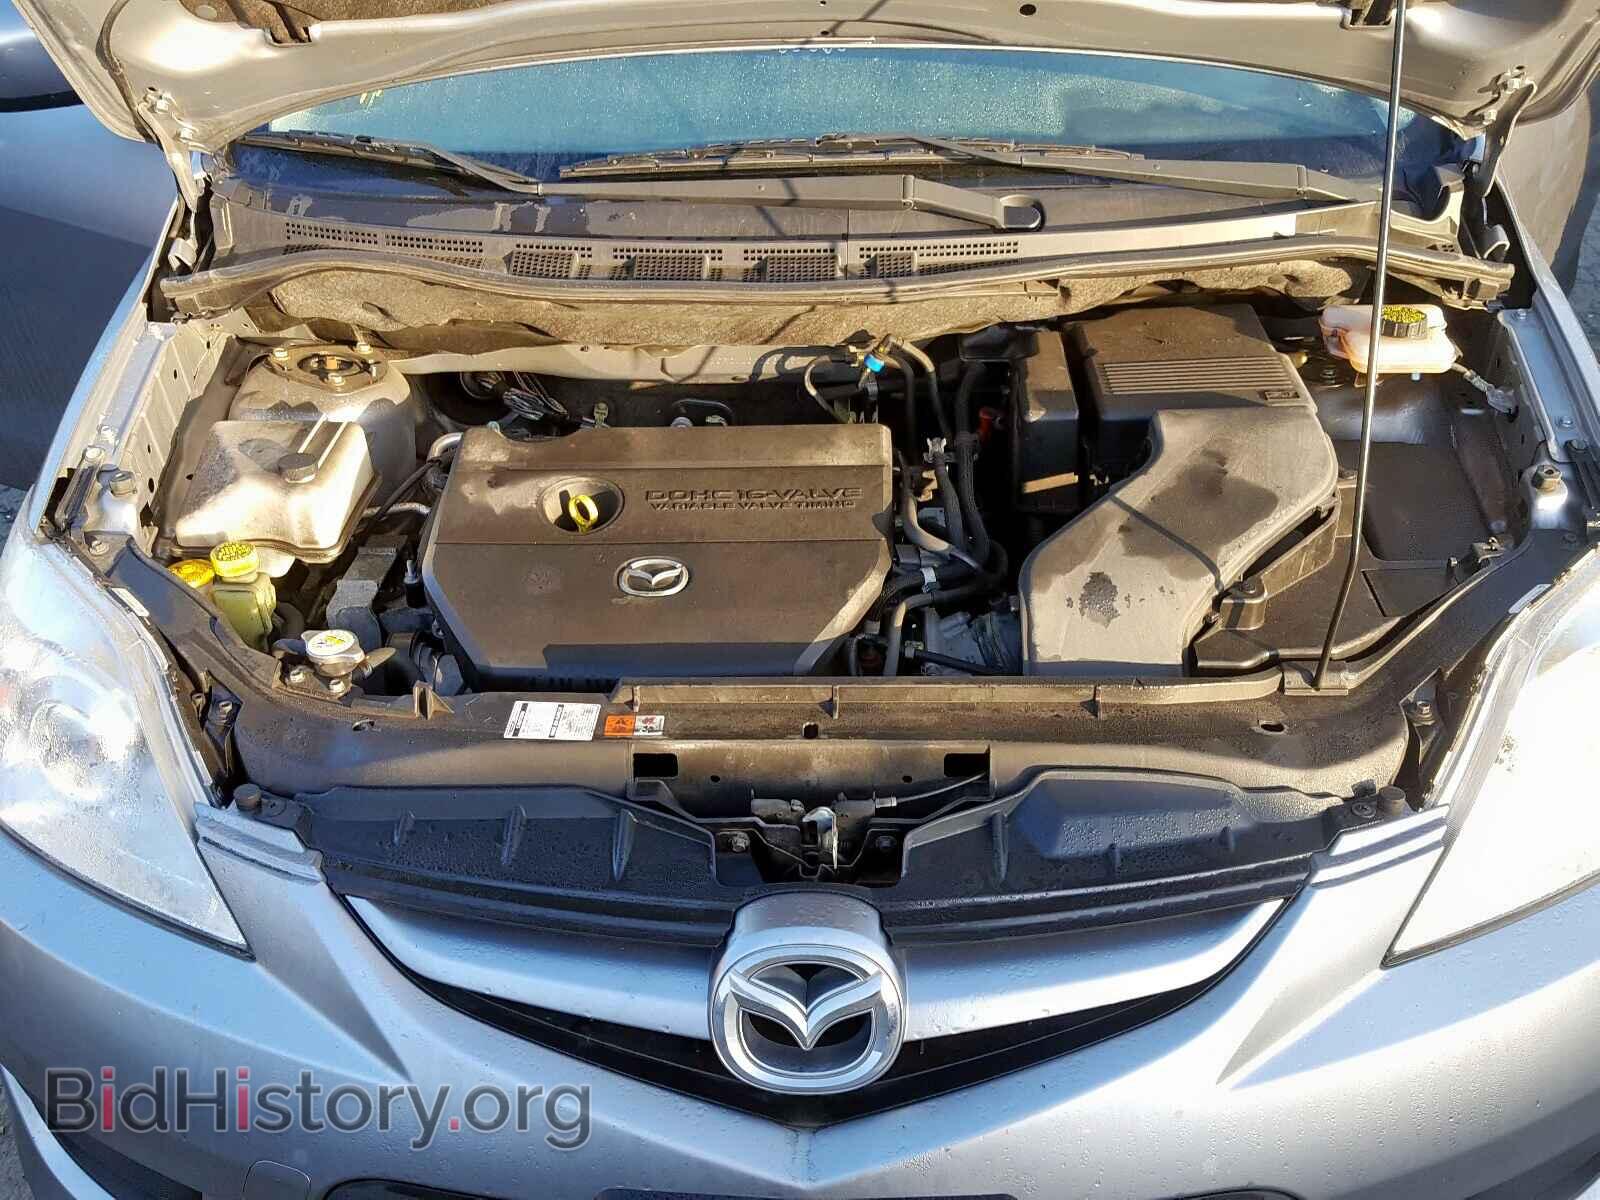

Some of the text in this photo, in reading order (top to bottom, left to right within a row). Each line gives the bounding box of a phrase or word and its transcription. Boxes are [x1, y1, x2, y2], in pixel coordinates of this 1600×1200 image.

[645, 487, 864, 502] DOHC 16-VALVE
[649, 502, 736, 511] VARIABLE
[737, 501, 793, 511] VALVE
